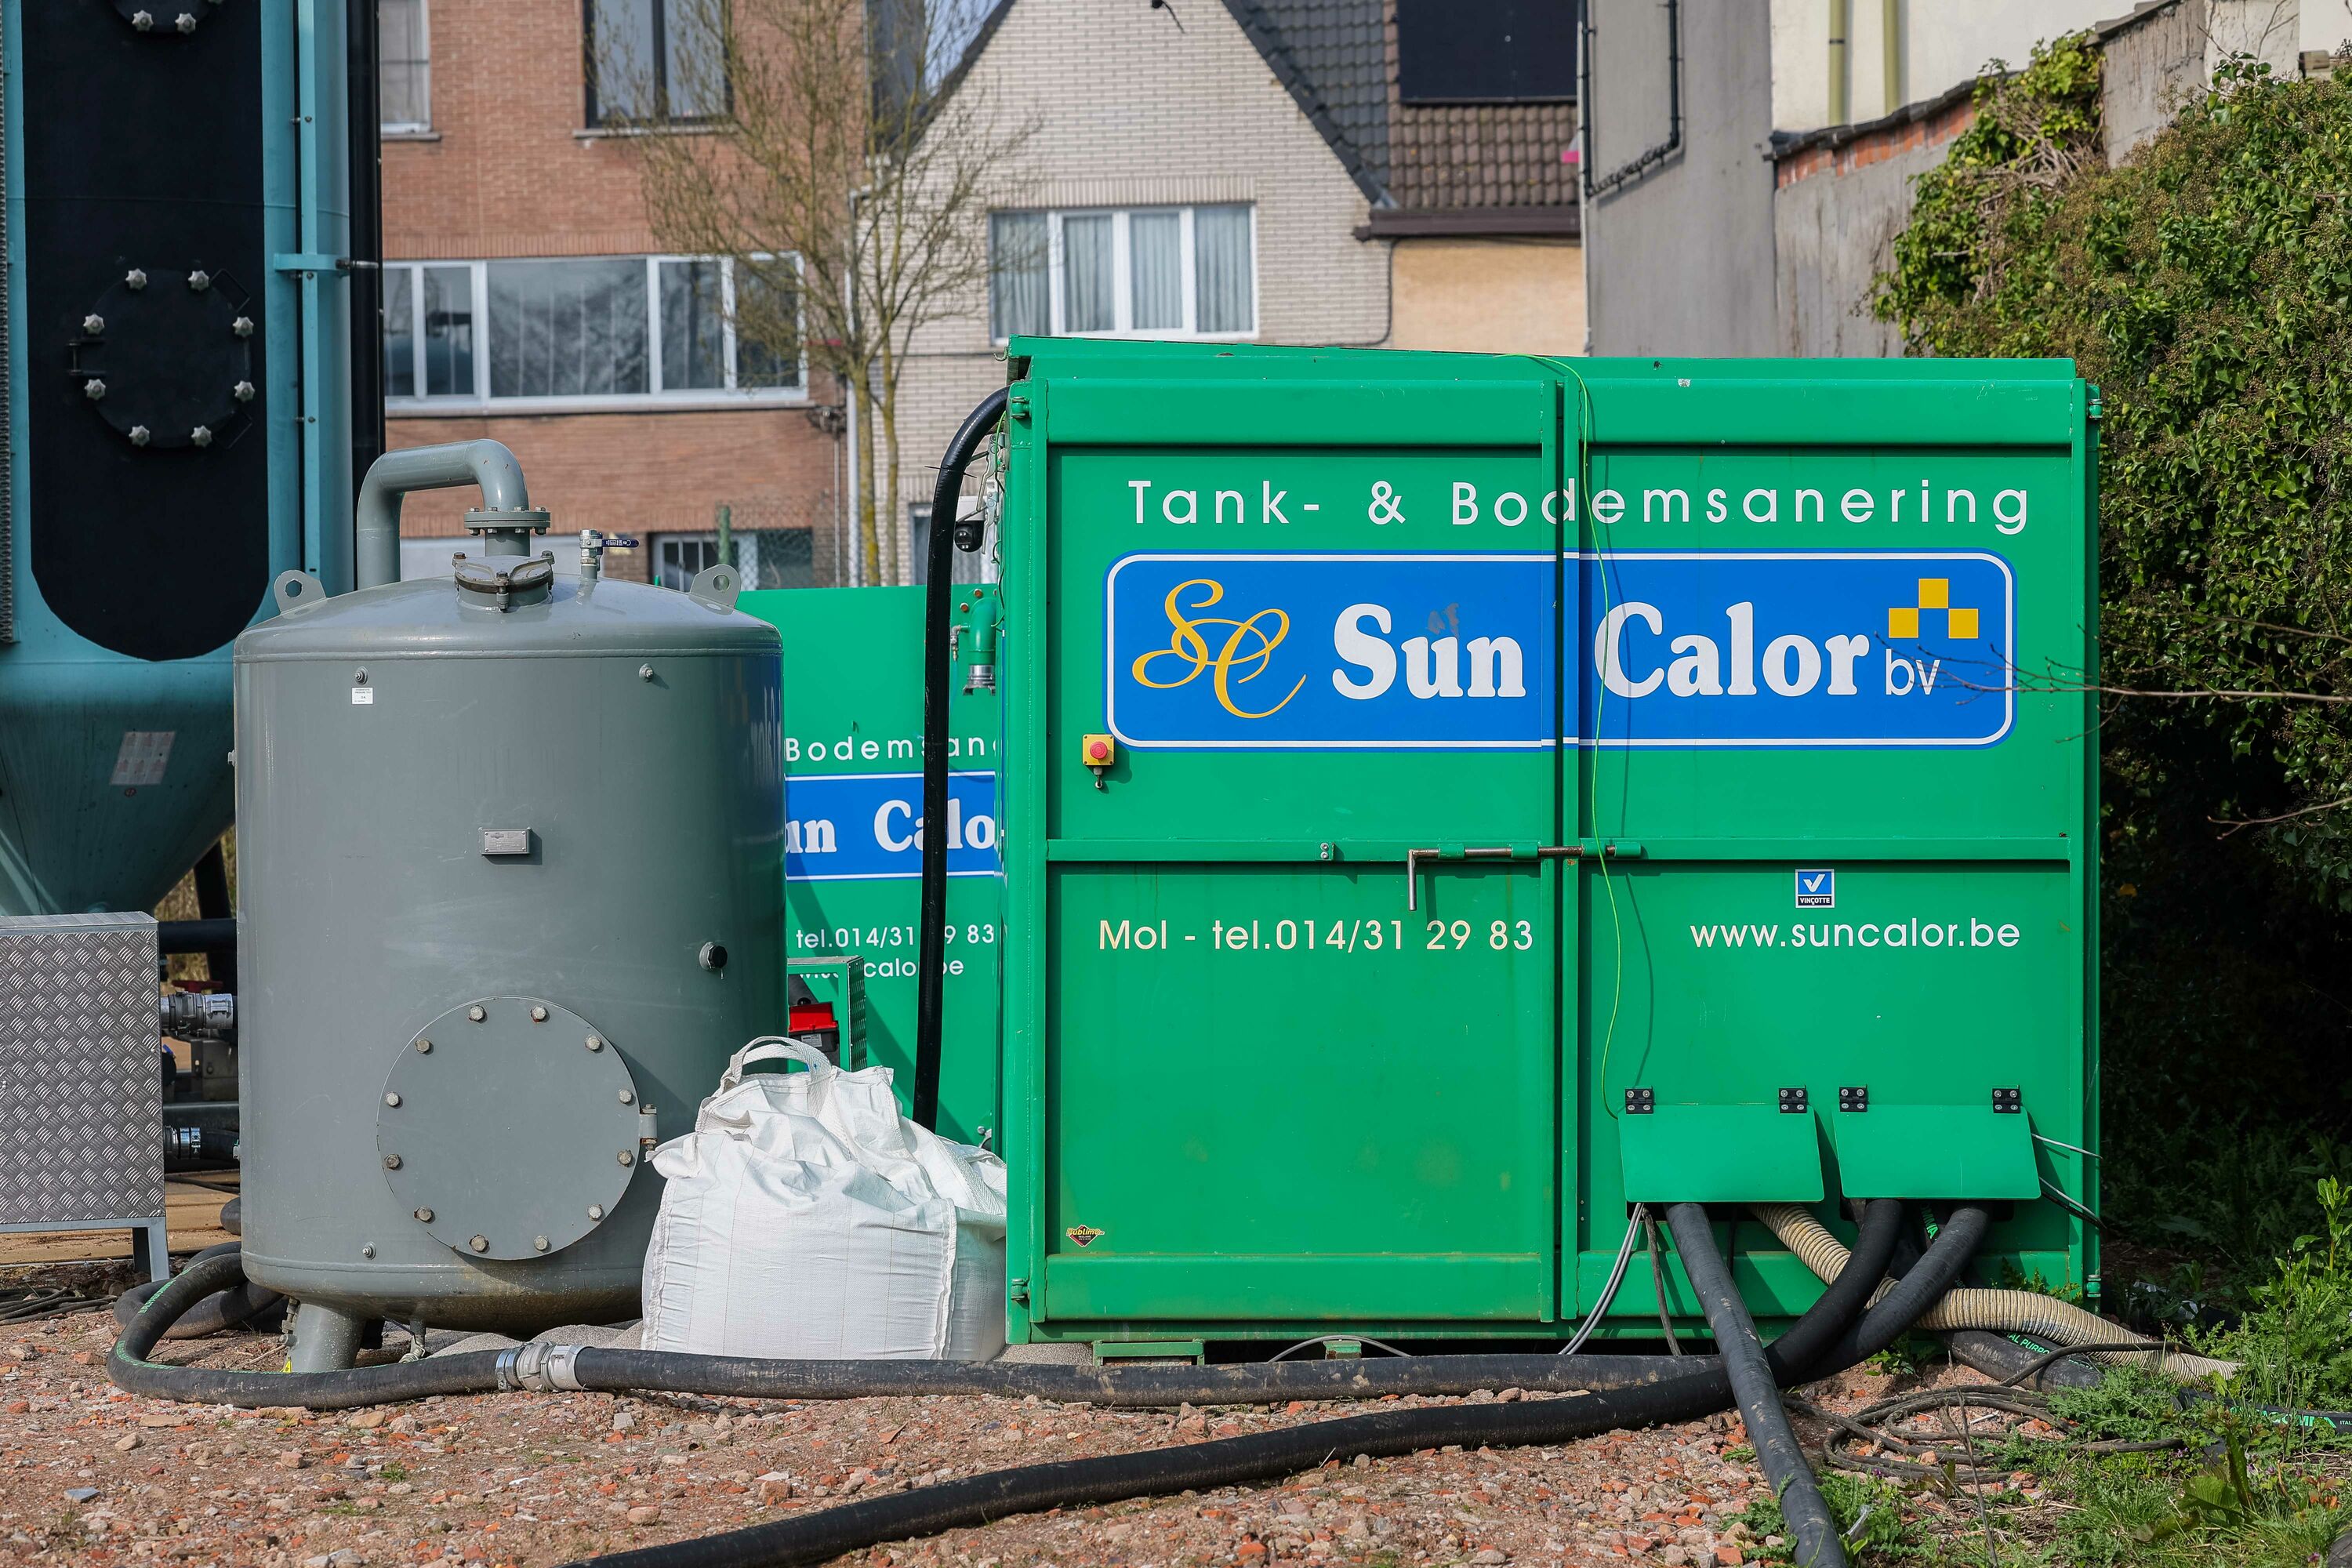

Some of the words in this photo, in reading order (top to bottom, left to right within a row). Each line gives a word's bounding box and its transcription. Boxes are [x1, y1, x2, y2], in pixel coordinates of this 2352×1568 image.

[1128, 481, 1320, 524] Tank-
[1368, 481, 1406, 526] &
[1453, 478, 2029, 536] Bodemsanering
[1332, 603, 1526, 701] Sun
[1594, 601, 1871, 699] Calor
[1885, 648, 1942, 697] bv
[786, 737, 996, 762] Bodeman
[1800, 897, 1831, 906] VINÇOTTE
[796, 927, 915, 949] tel.014/31
[967, 924, 995, 946] 83
[1099, 920, 1167, 951] Mol
[1213, 920, 1402, 954] tel.014/31
[1426, 920, 1472, 951] 29
[1490, 920, 1534, 951] 83
[1690, 917, 2021, 949] www.suncalor.be
